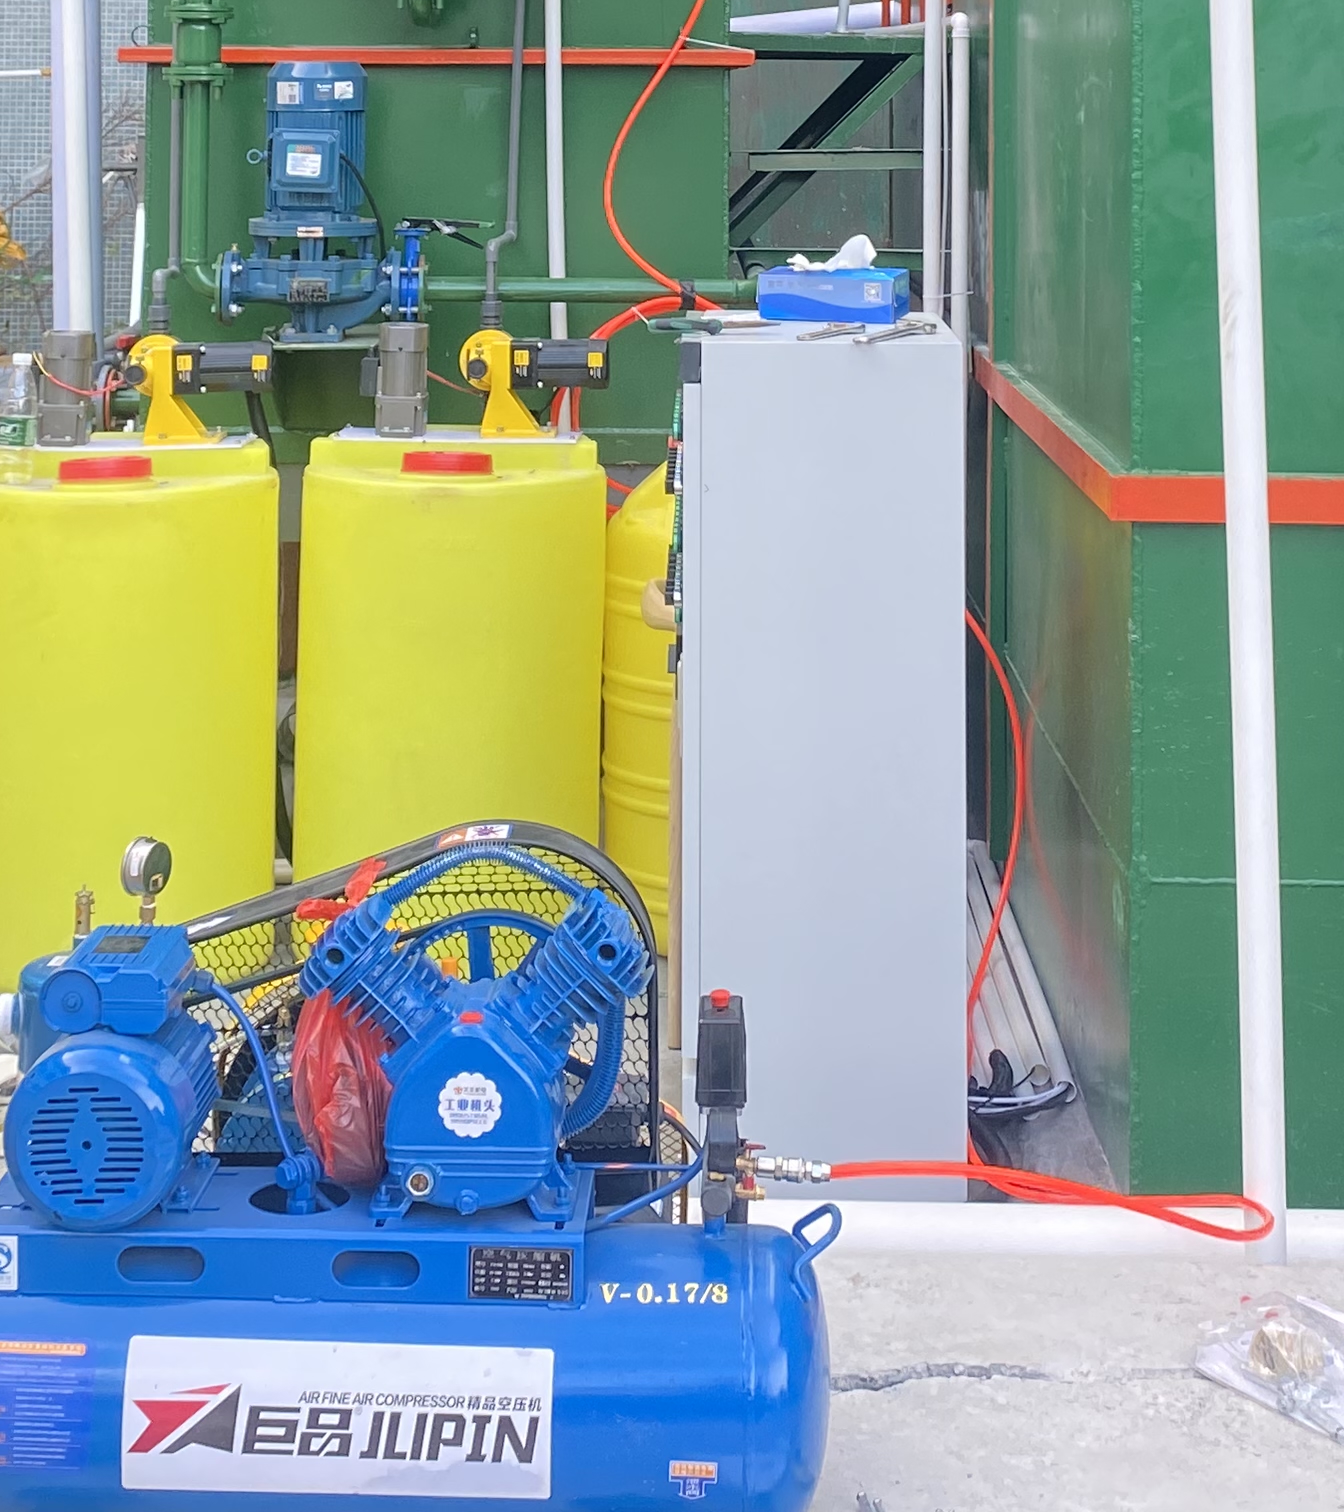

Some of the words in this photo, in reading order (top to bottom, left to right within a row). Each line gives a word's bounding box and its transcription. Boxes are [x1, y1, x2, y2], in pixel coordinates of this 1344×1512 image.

[599, 1281, 730, 1305] V-0.17/8
[298, 1390, 320, 1405] AIR
[321, 1391, 351, 1406] FINE
[351, 1392, 374, 1407] AIR
[375, 1392, 466, 1409] COMPRESSOR
[466, 1395, 543, 1412] 精品空压机
